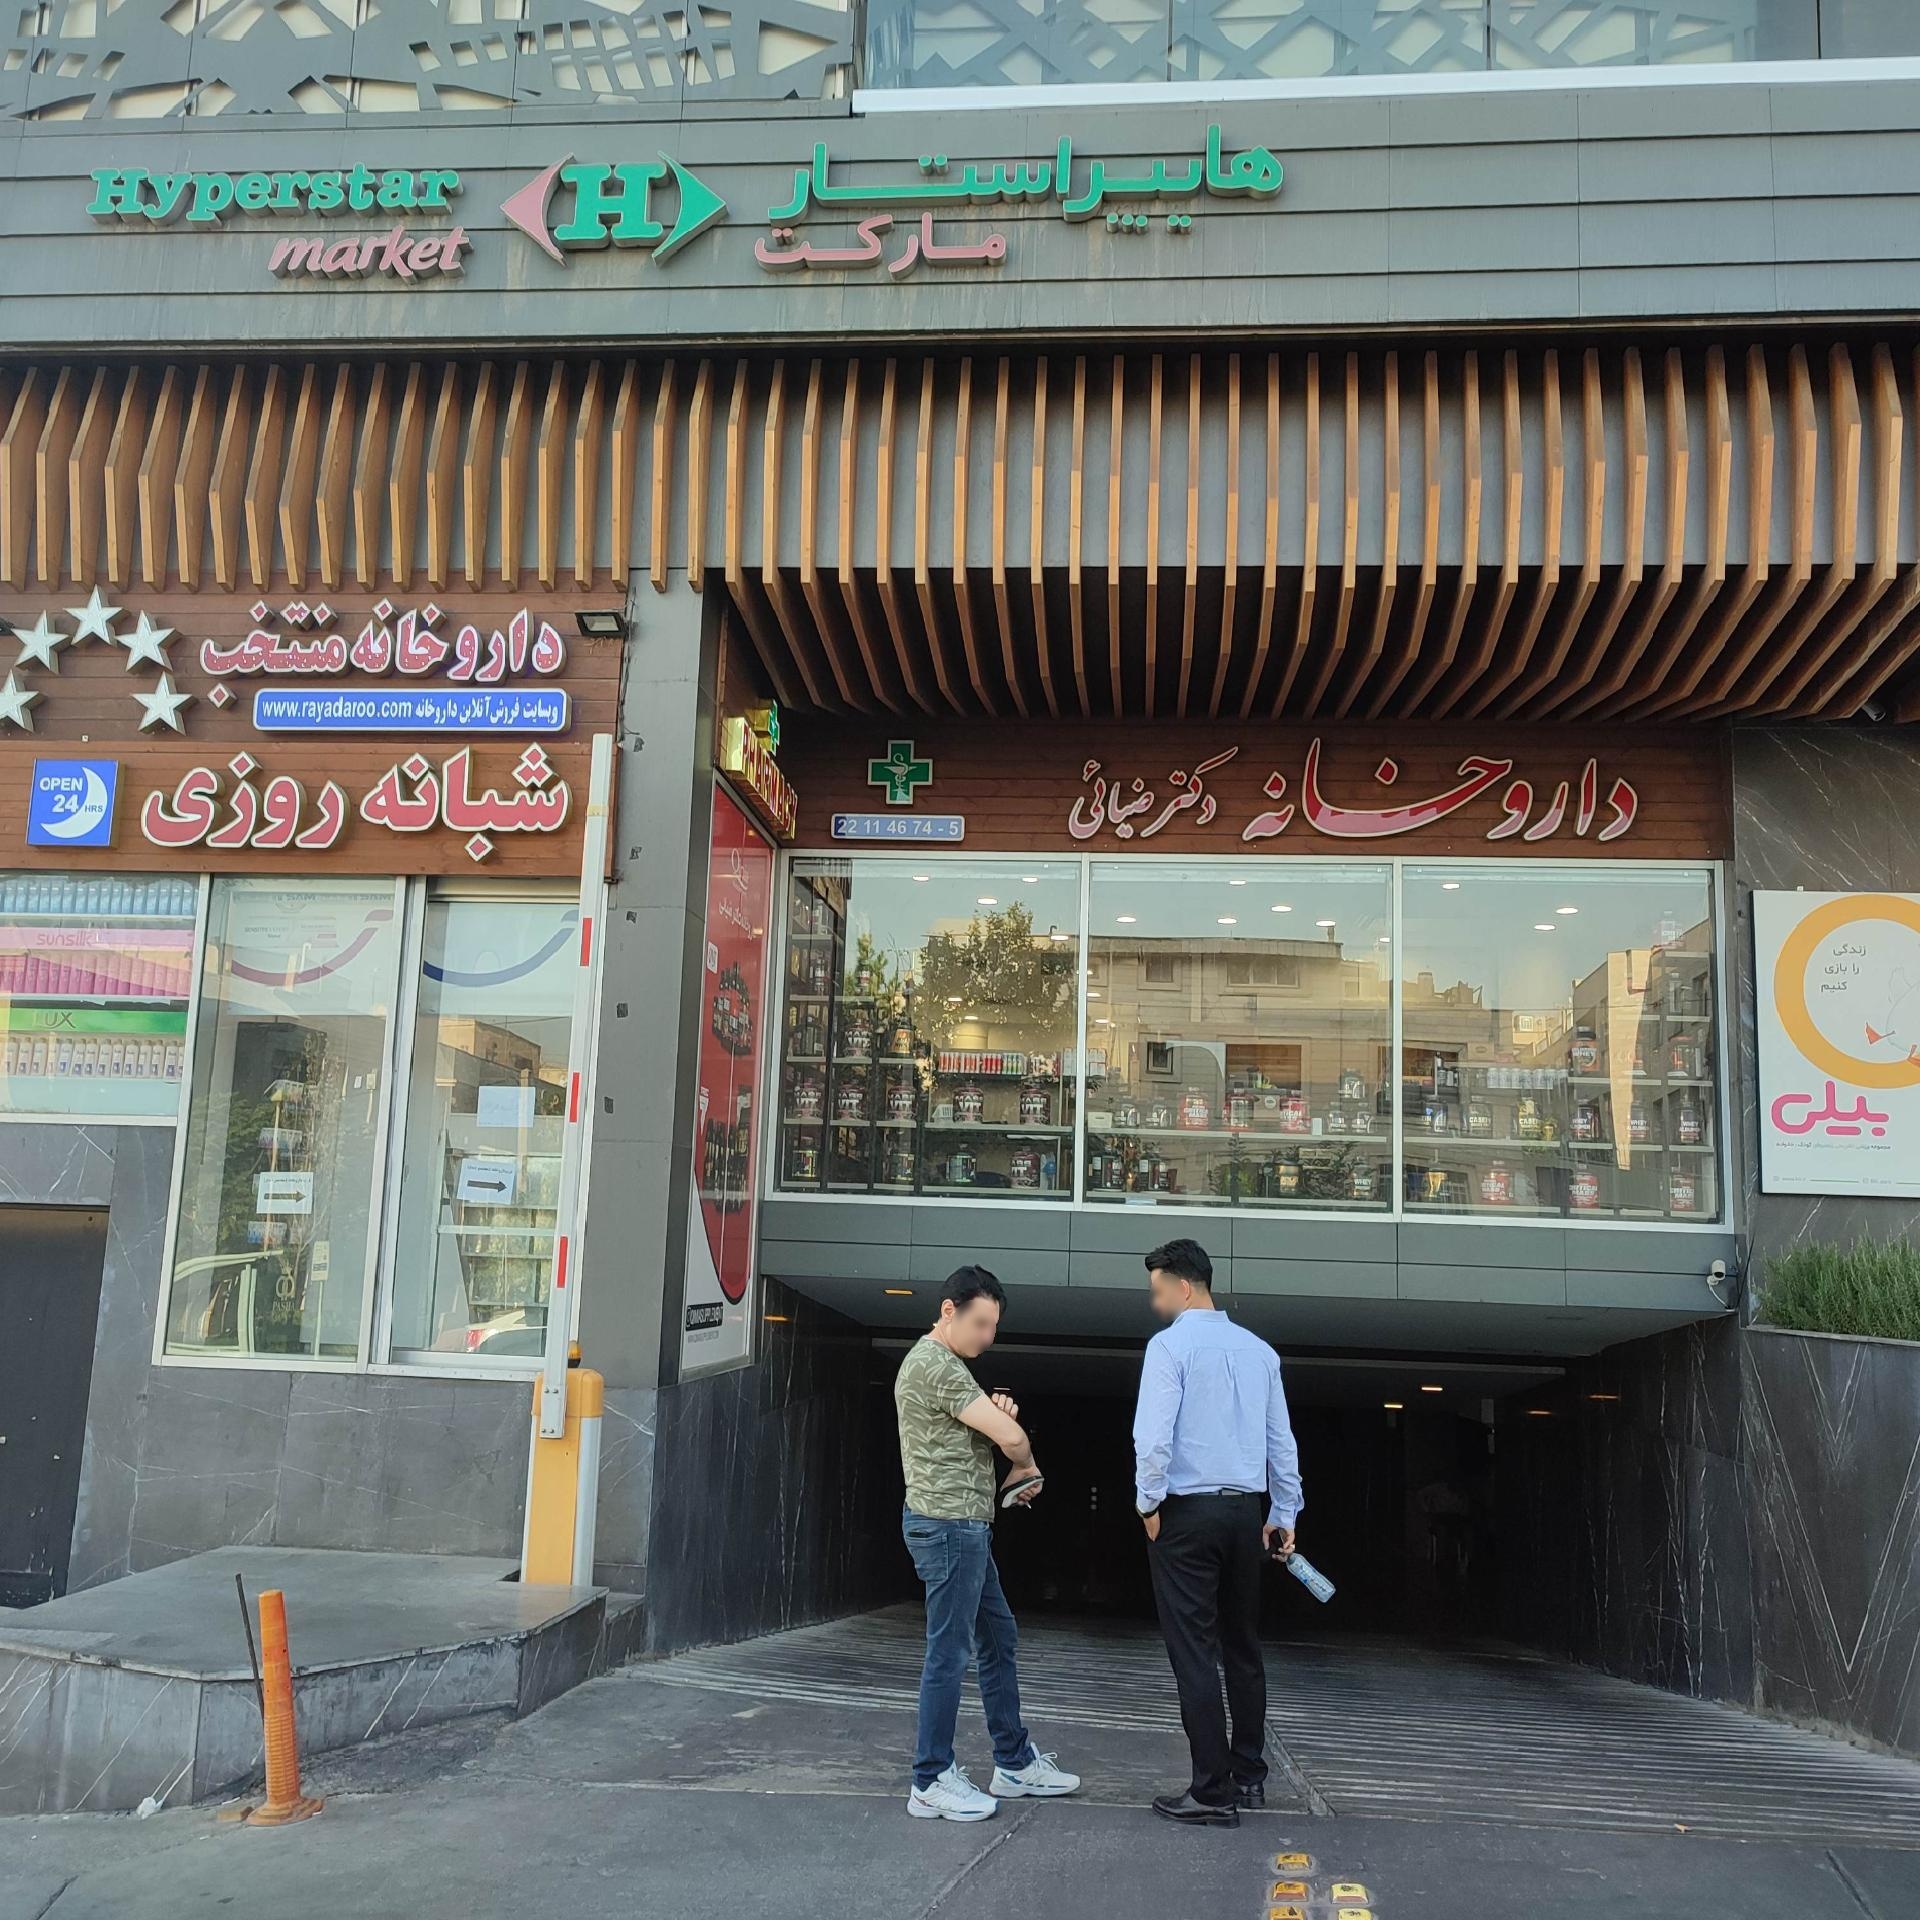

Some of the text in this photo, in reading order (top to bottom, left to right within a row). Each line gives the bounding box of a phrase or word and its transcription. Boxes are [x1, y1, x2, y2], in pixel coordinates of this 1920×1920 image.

[86, 162, 462, 224] Hyperstar
[768, 124, 1285, 236] هایپراستار
[268, 226, 471, 280] market
[755, 212, 1007, 280] مارکت
[200, 599, 347, 709] منتخب
[262, 696, 412, 722] www.rayadaroo.com
[39, 776, 83, 792] OPEN
[52, 793, 103, 814] 24 HRS
[141, 743, 568, 862] شبانه روزی
[1141, 746, 1239, 838] دکتر
[837, 819, 857, 835] 22
[864, 819, 880, 835] 11
[887, 819, 907, 835] 46
[913, 820, 932, 835] 74
[949, 820, 959, 836] 5
[1824, 962, 1860, 975] را بازی
[1833, 943, 1867, 957] زندگی
[1820, 980, 1848, 993] کنیم
